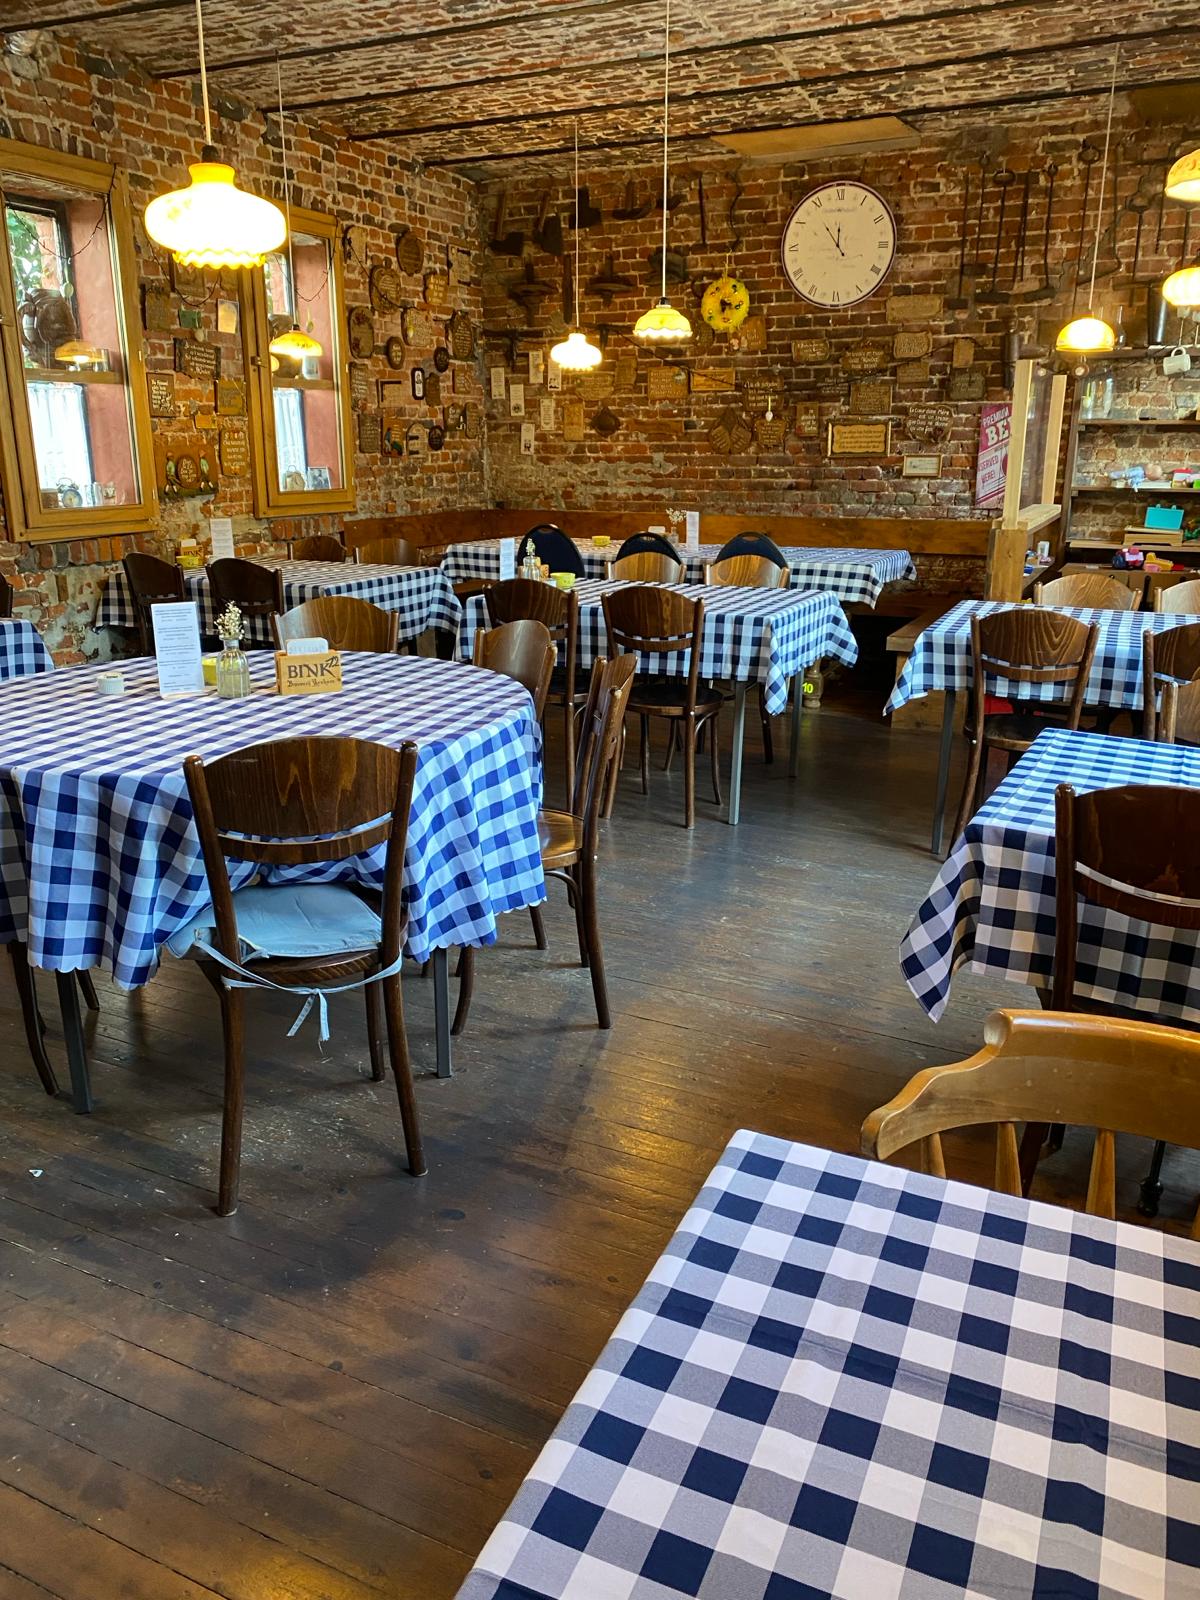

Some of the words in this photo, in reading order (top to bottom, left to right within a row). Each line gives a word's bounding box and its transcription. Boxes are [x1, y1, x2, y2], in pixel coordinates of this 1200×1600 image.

[983, 406, 1009, 428] PREMIUM
[287, 663, 336, 679] BINK
[801, 682, 814, 694] 10
